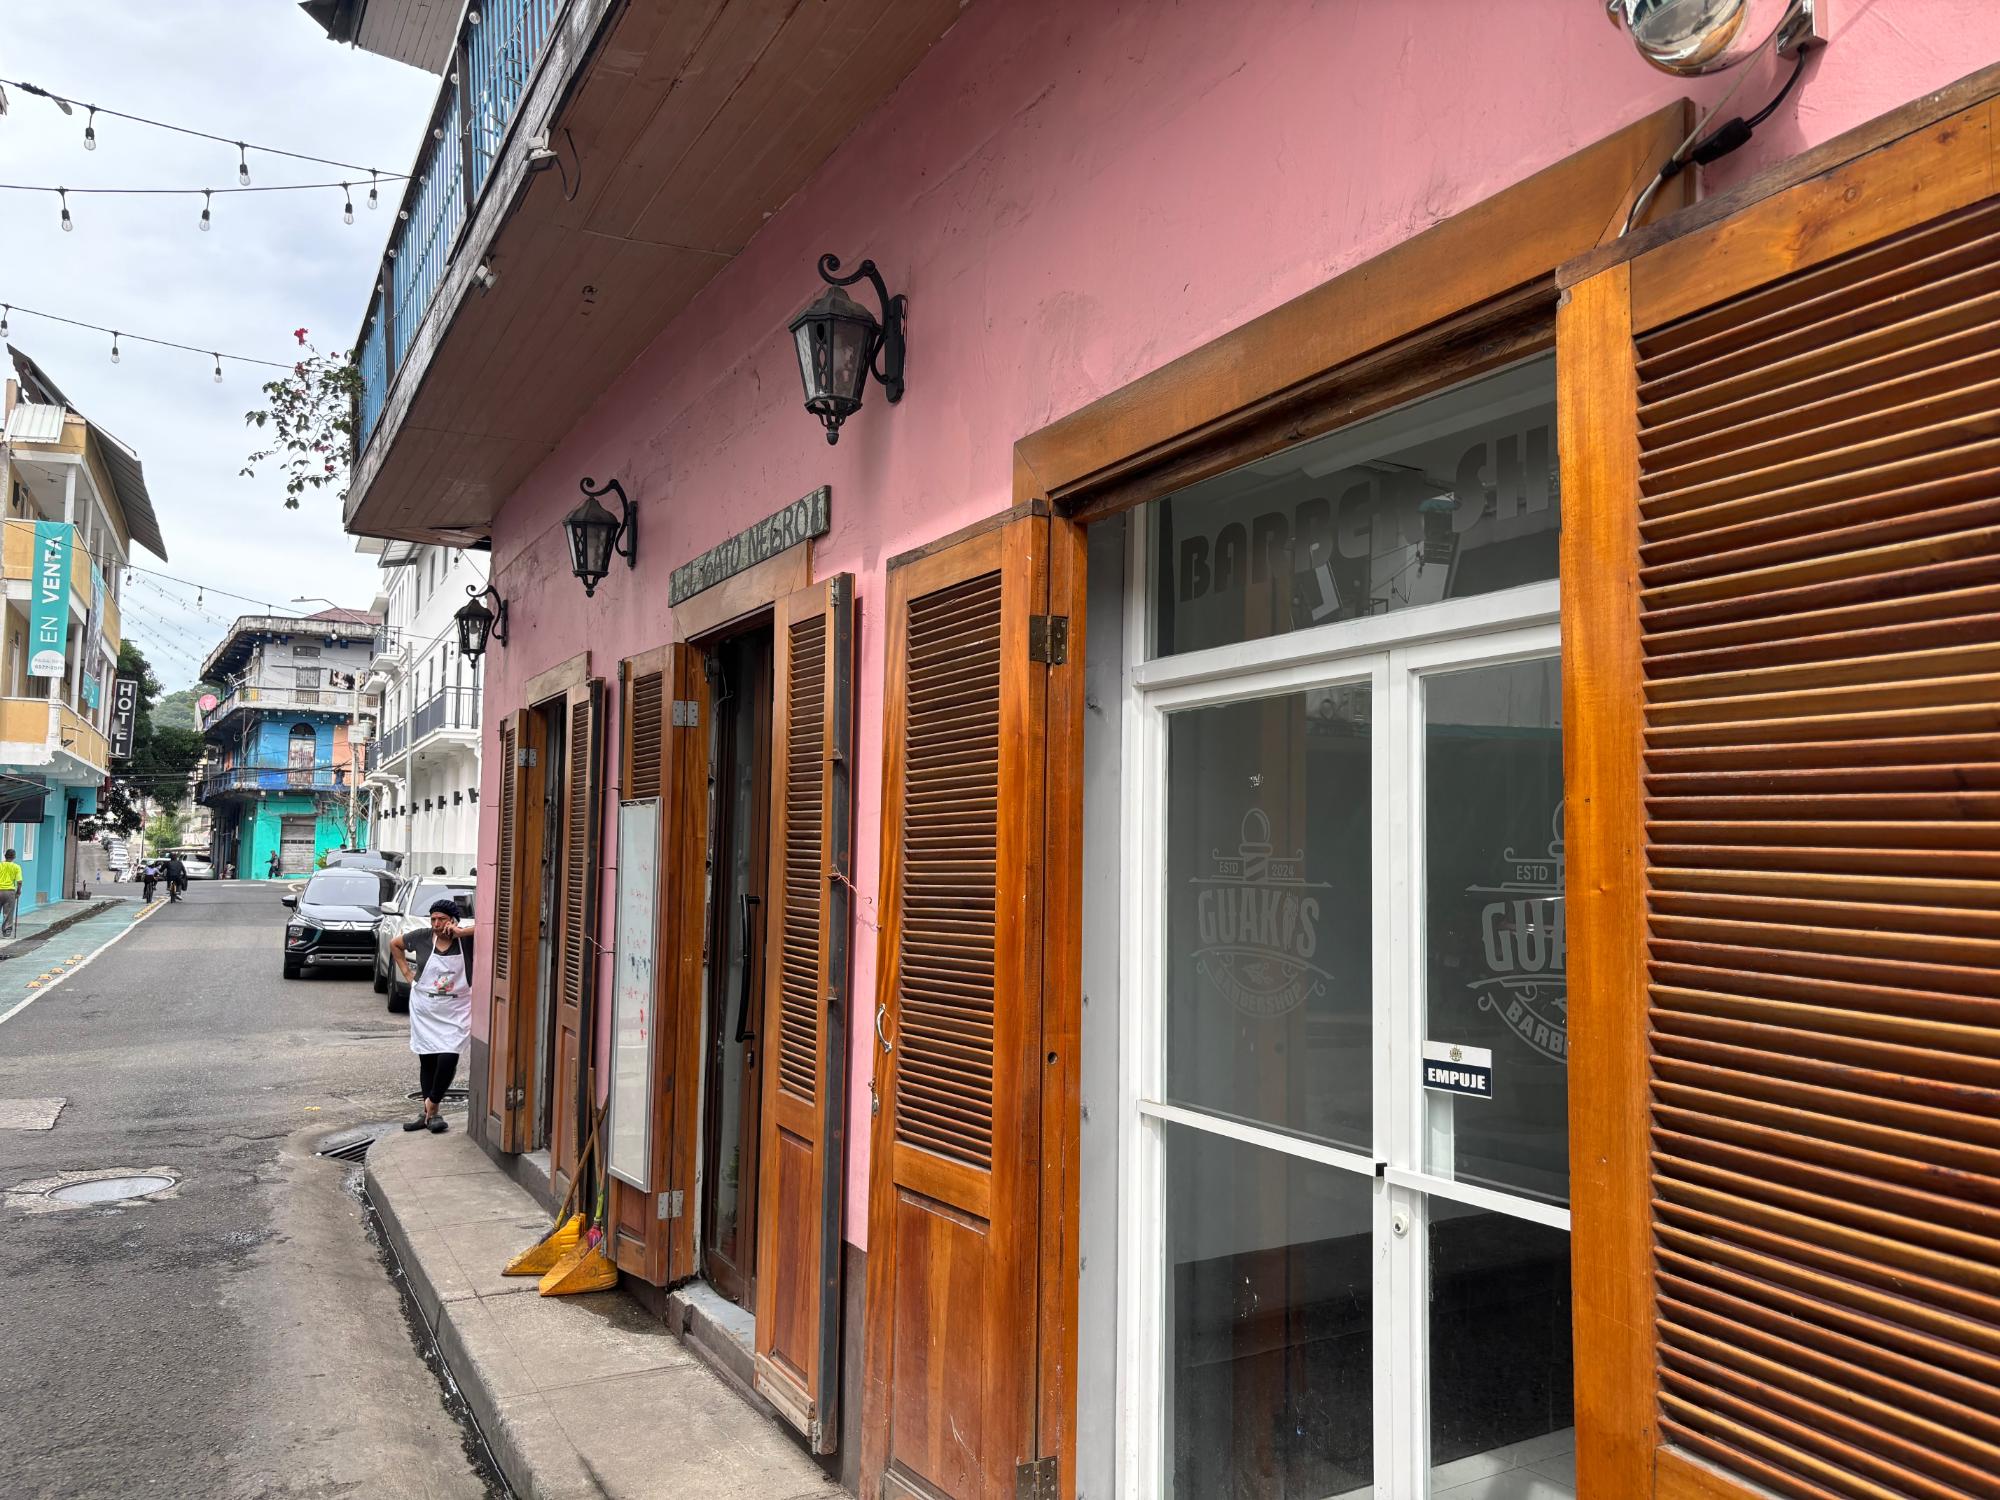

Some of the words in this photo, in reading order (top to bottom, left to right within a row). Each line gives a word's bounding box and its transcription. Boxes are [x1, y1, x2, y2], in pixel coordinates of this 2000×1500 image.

[702, 534, 742, 588] GATO
[748, 499, 809, 564] NEGRO
[42, 535, 62, 604] VENTA
[40, 616, 58, 643] EN
[115, 683, 133, 757] HOTEL
[1219, 861, 1239, 874] ESTD
[1271, 863, 1295, 878] 2024
[1516, 864, 1549, 881] ESTD
[1506, 1000, 1568, 1056] BARB
[1427, 1067, 1486, 1091] EMPUJE
